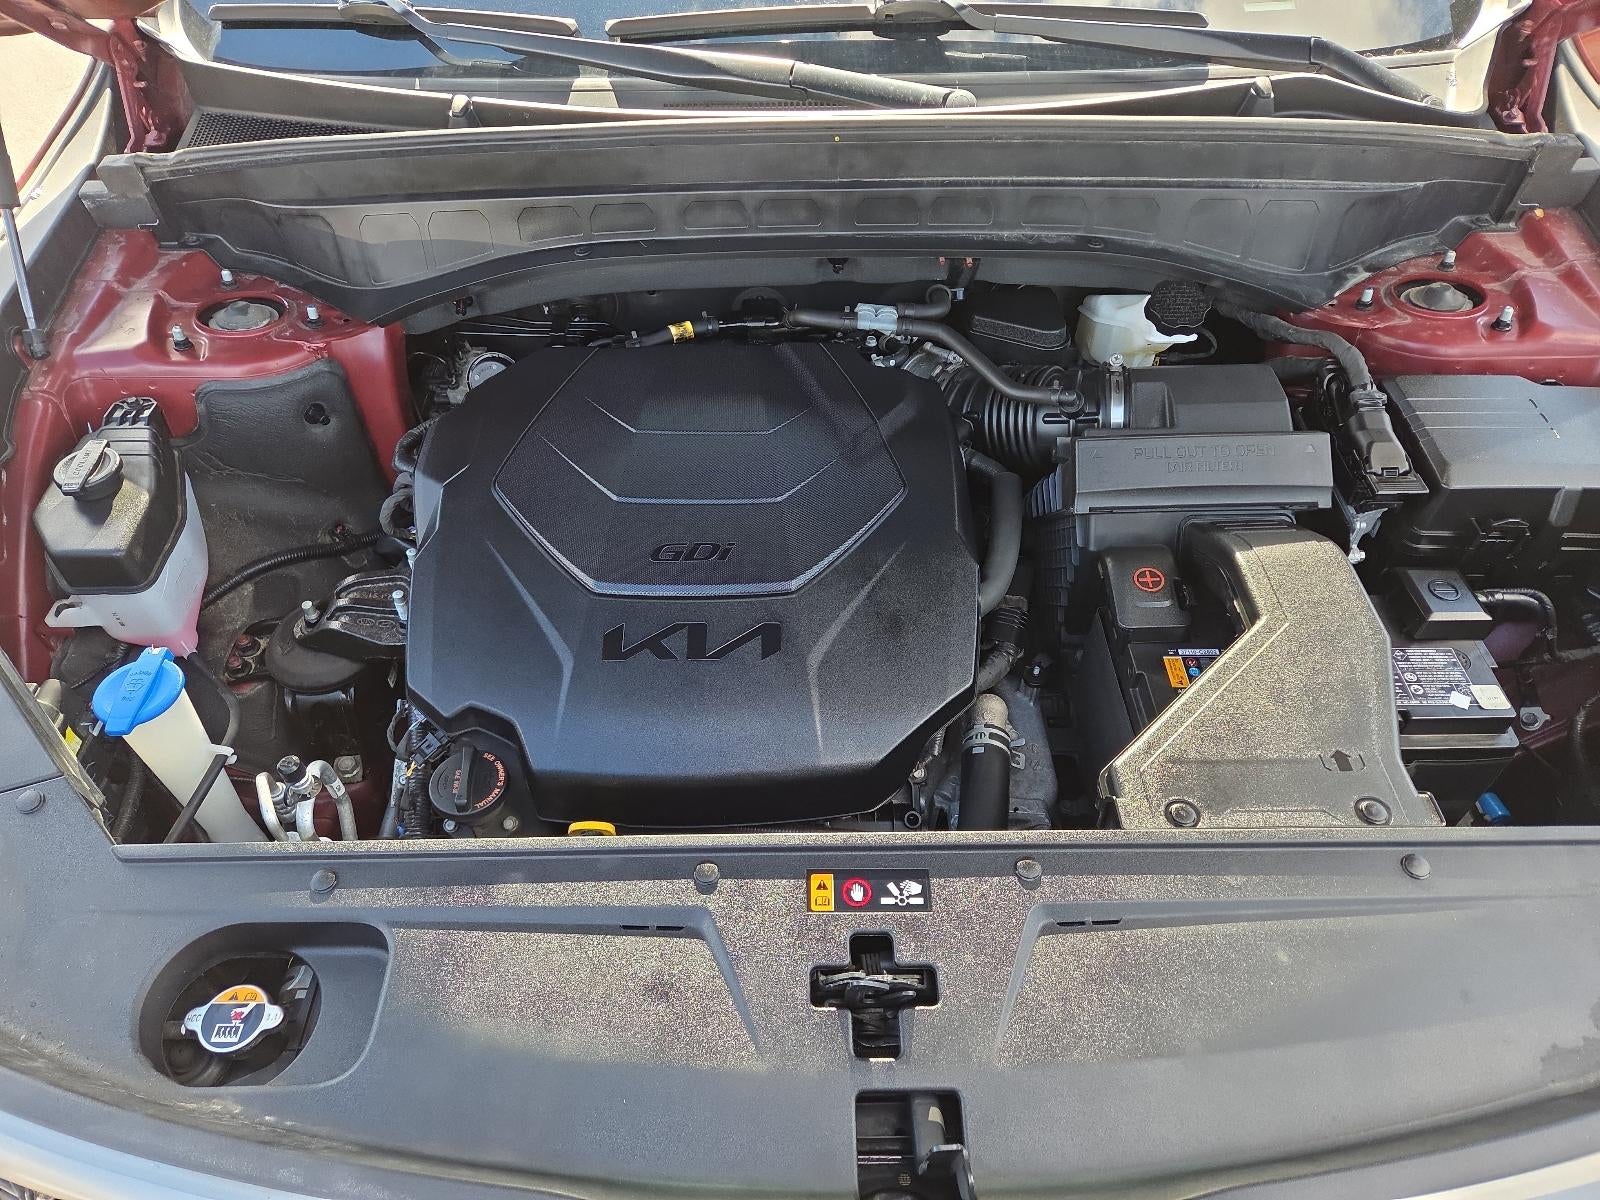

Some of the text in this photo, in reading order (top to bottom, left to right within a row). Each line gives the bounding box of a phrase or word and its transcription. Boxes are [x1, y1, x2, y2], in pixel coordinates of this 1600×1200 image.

[1133, 443, 1276, 459] PULL OUT TO OPEN
[650, 542, 736, 562] GDi
[602, 621, 782, 661] KIA
[474, 752, 506, 809] SEE OWNER'S MANUAL
